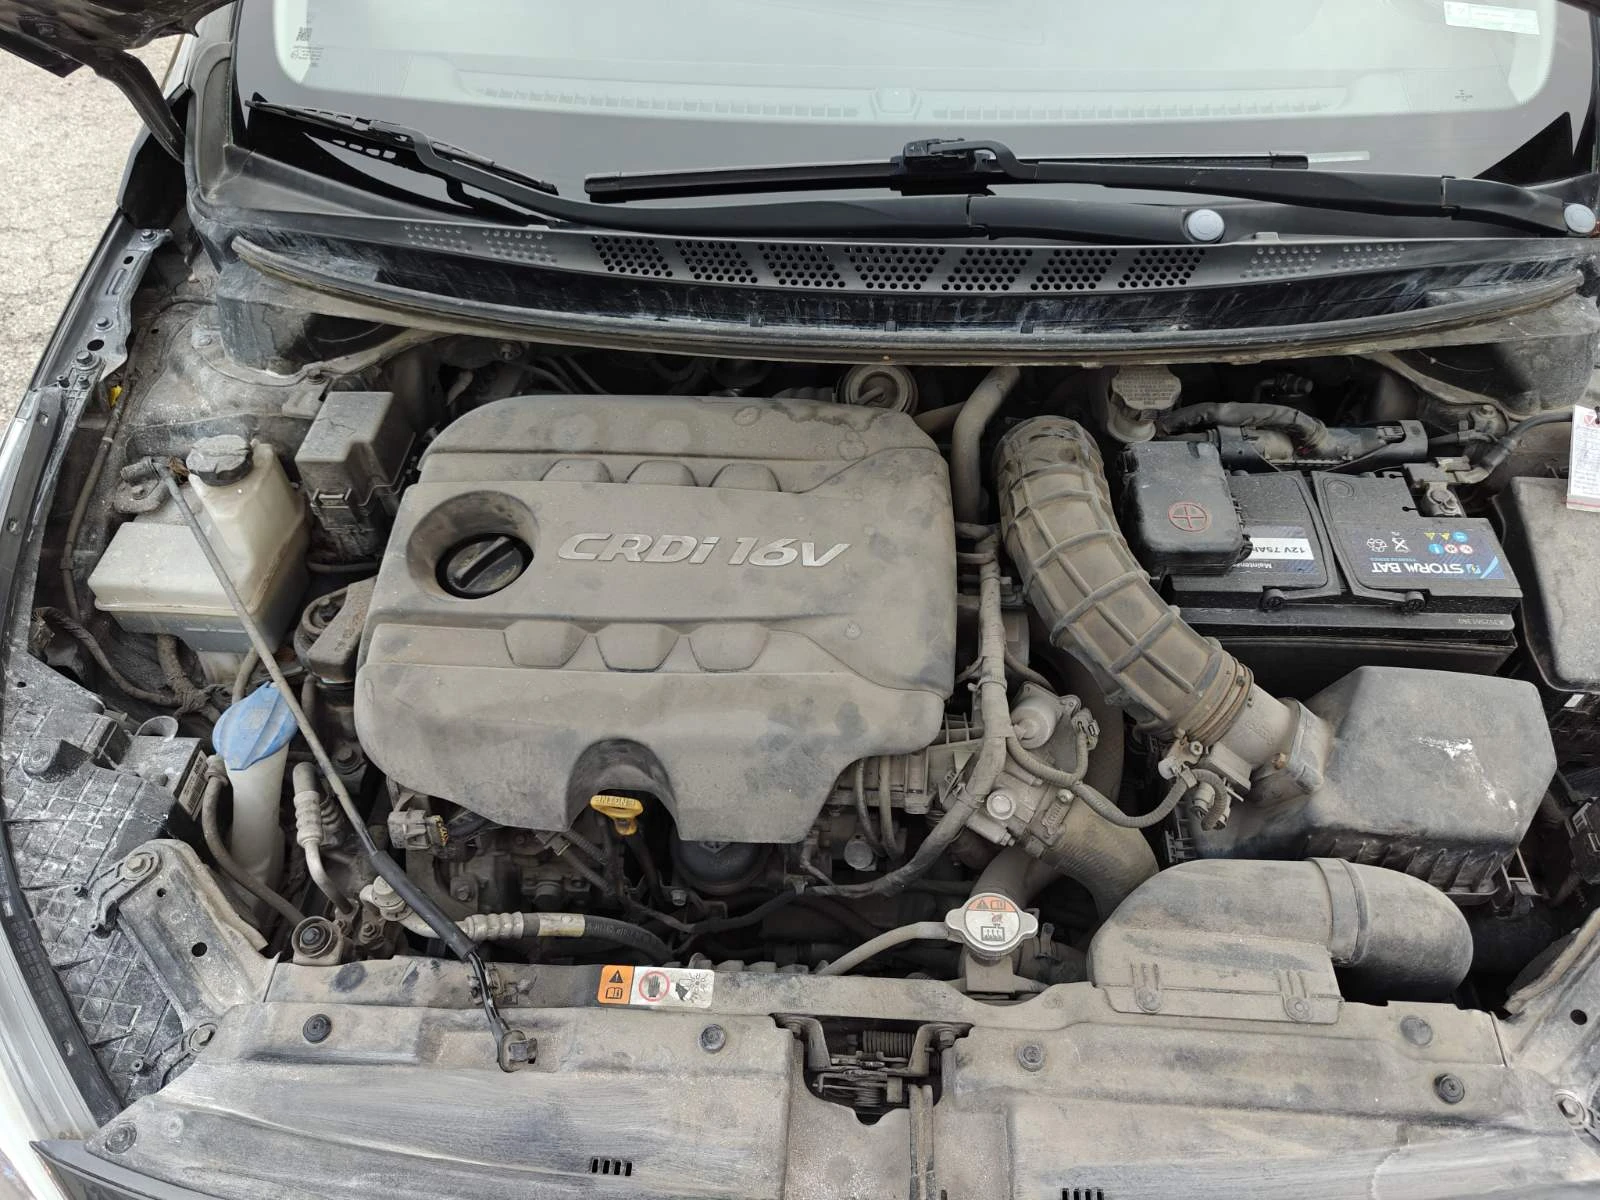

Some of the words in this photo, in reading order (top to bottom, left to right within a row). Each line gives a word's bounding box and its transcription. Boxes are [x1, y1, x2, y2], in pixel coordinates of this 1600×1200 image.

[557, 533, 720, 565] CRDi
[728, 537, 851, 567] 16V
[1284, 546, 1306, 554] 12V
[1371, 562, 1402, 573] BAT
[1405, 562, 1464, 574] STORM
